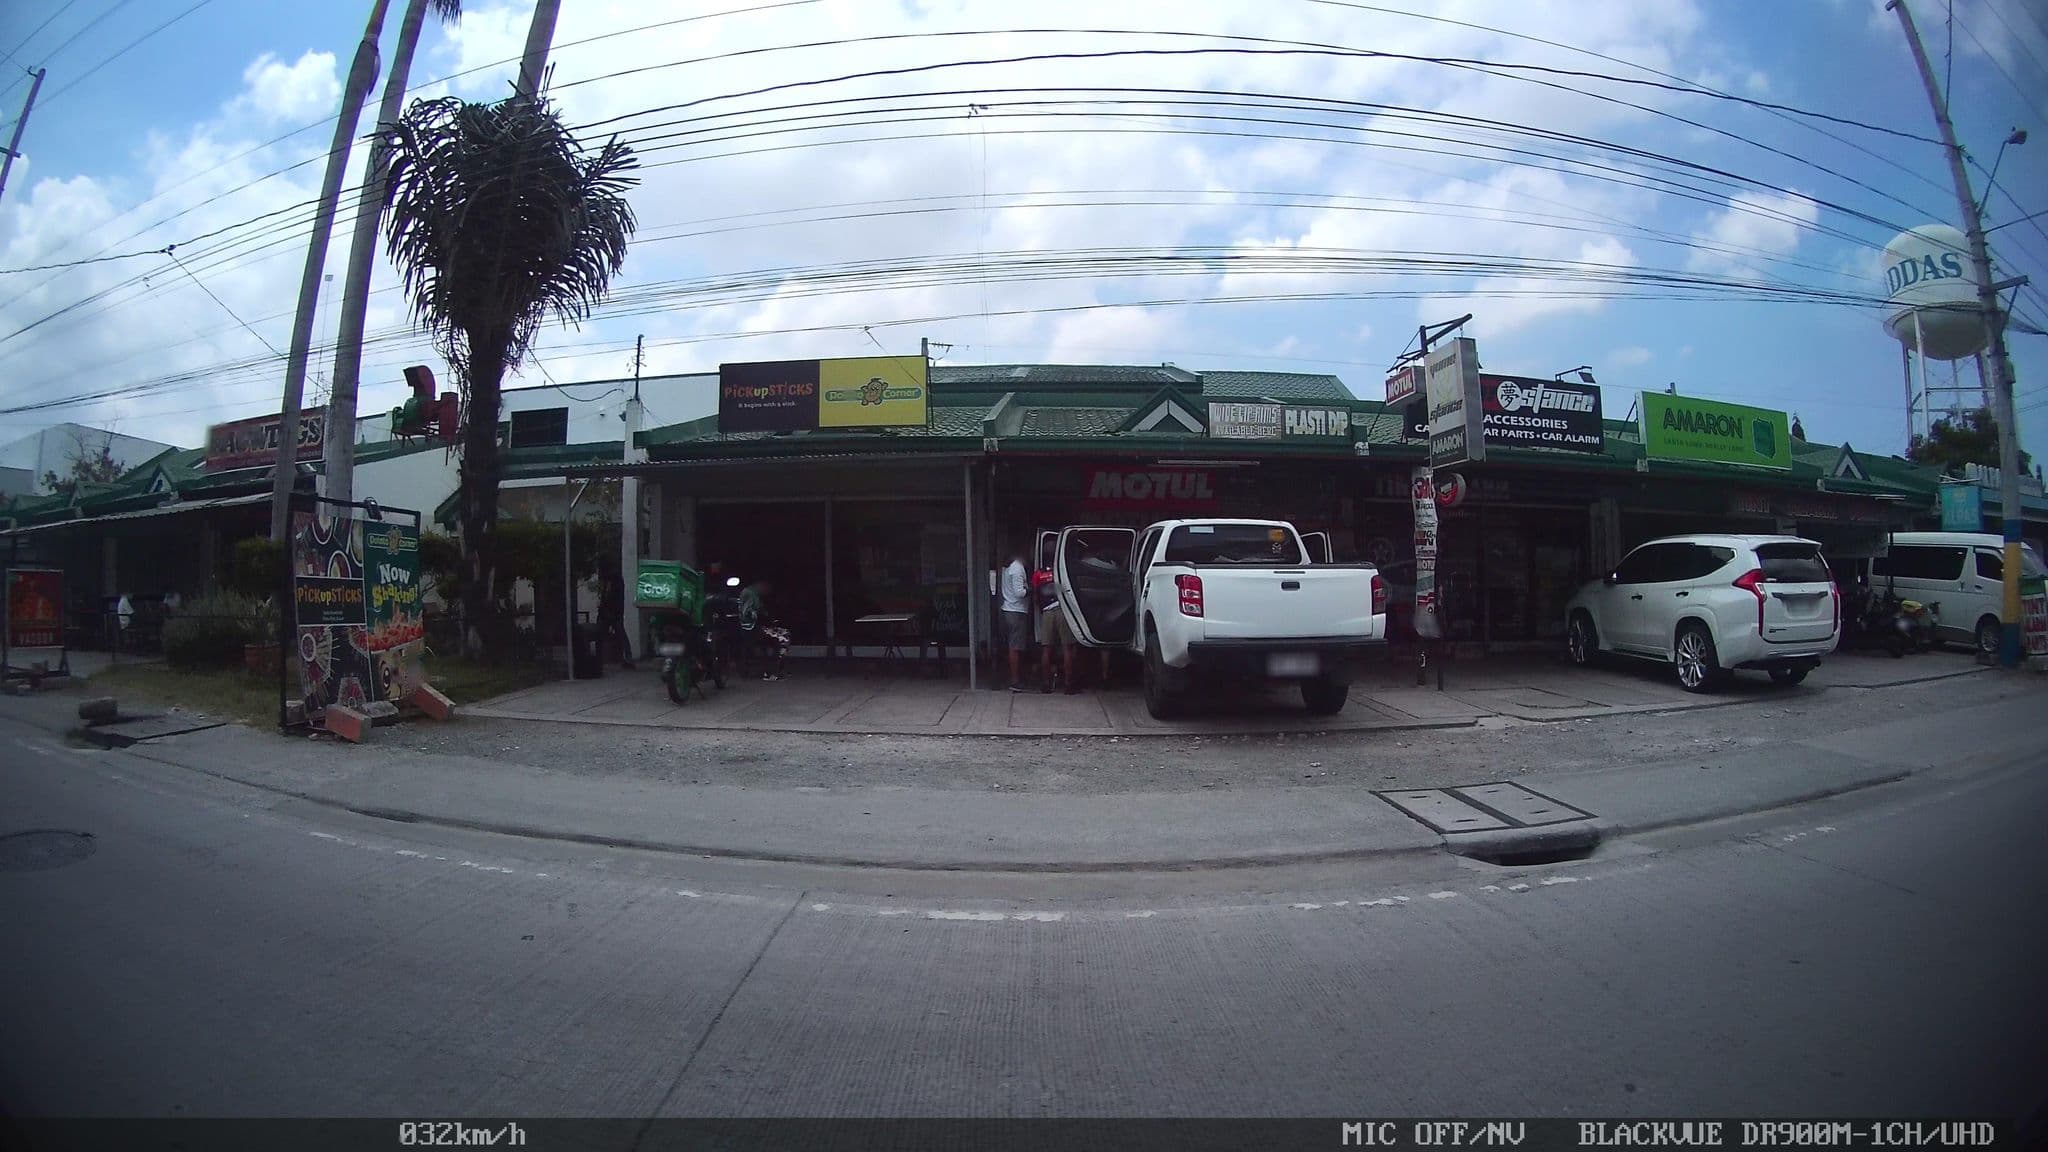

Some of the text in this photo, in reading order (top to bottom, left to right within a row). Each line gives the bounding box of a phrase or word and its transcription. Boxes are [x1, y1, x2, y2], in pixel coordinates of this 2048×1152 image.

[1387, 373, 1413, 399] MOTUL
[1520, 383, 1595, 414] stance
[1285, 409, 1326, 435] PLASTI
[1483, 414, 1568, 429] ACCESSORIES
[1662, 406, 1744, 439] AMARON
[1414, 424, 1600, 445] CA AR PARTS CAR ALARM
[1432, 432, 1465, 455] AMARON
[1088, 471, 1214, 498] MOTUL
[379, 563, 411, 585] Now
[644, 583, 671, 596] Grab
